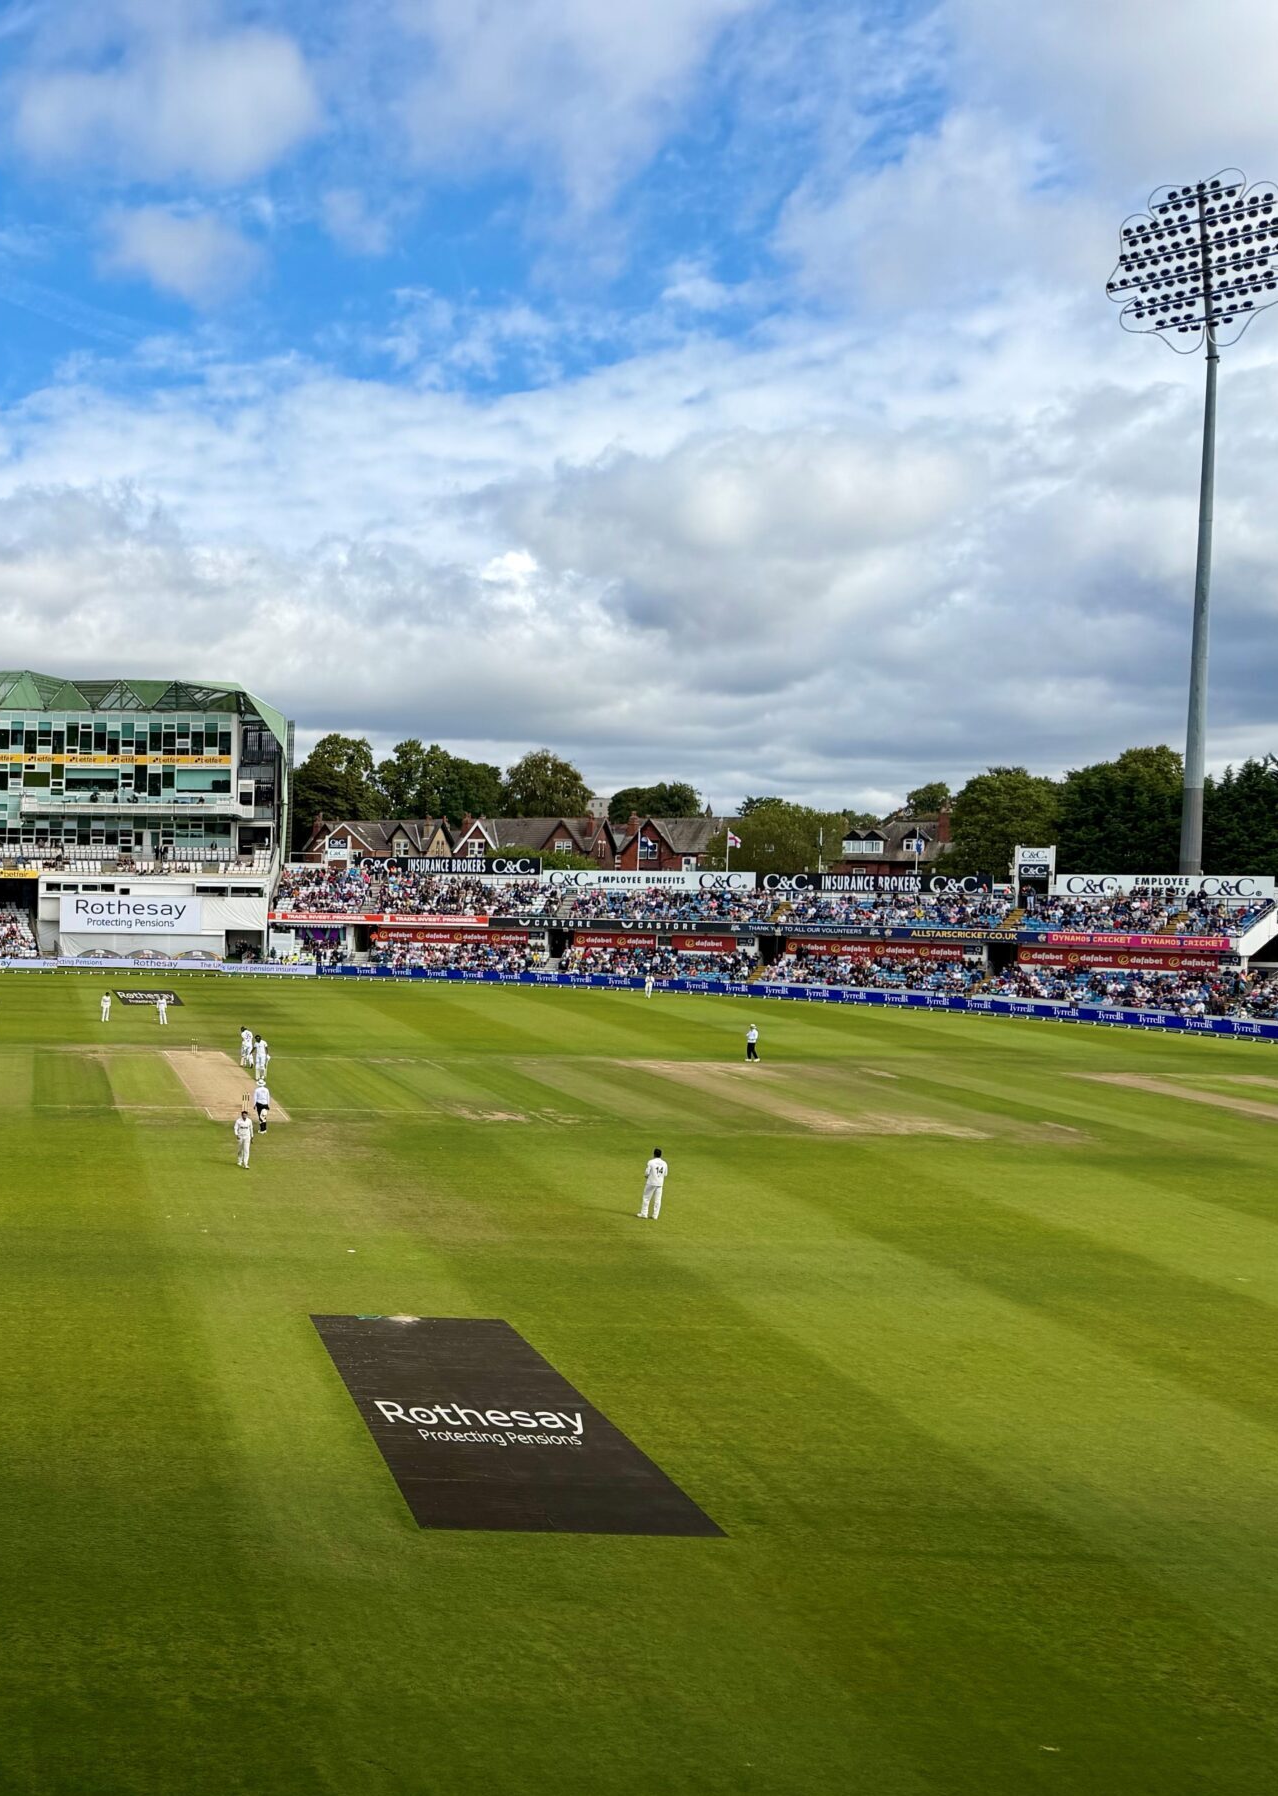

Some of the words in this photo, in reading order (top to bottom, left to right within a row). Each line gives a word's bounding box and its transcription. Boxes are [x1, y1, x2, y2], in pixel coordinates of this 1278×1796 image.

[408, 859, 449, 872] INSURANCE
[452, 859, 486, 872] BROKERS
[4, 870, 28, 878] betfair
[598, 876, 641, 884] EMPLOYEE
[646, 876, 686, 884] BENEFITS
[822, 875, 874, 890] INSURANCE
[878, 876, 922, 892] BROKERS
[1135, 877, 1190, 886] EMPLOYEE
[76, 898, 186, 920] Rothesay
[86, 917, 132, 928] Protecting
[135, 918, 174, 928] Pensions
[534, 920, 591, 928] CASTORE
[638, 922, 696, 931] CASTORE
[388, 931, 413, 939] dafabet
[426, 932, 450, 940] dafabet
[500, 934, 526, 942] dafabet
[911, 930, 1018, 940] ALLSTARSCRICKET.CO.UK
[1052, 934, 1090, 943] DYNAMOS
[1092, 936, 1132, 944] CRICKET
[586, 936, 612, 944] dafabet
[626, 936, 654, 946] dafabet
[695, 938, 723, 948] dafabet
[1140, 938, 1180, 946] DYNAMOS
[1183, 939, 1224, 948] CRICKET
[842, 944, 870, 952] dafabet
[886, 946, 914, 954] dafabet
[930, 948, 960, 956] dafabet
[1032, 952, 1064, 960] dafabet
[1080, 954, 1113, 962] dafabet
[1130, 956, 1163, 965] dafabet
[76, 958, 102, 966] Pensions
[134, 959, 178, 969] Rothesay
[1182, 958, 1216, 968] dafabet
[226, 964, 248, 974] largest
[250, 966, 274, 974] pension
[656, 1166, 664, 1174] 14
[374, 1400, 584, 1435] Rothesay
[417, 1428, 508, 1448] Protecting
[507, 1431, 582, 1446] Pensions
